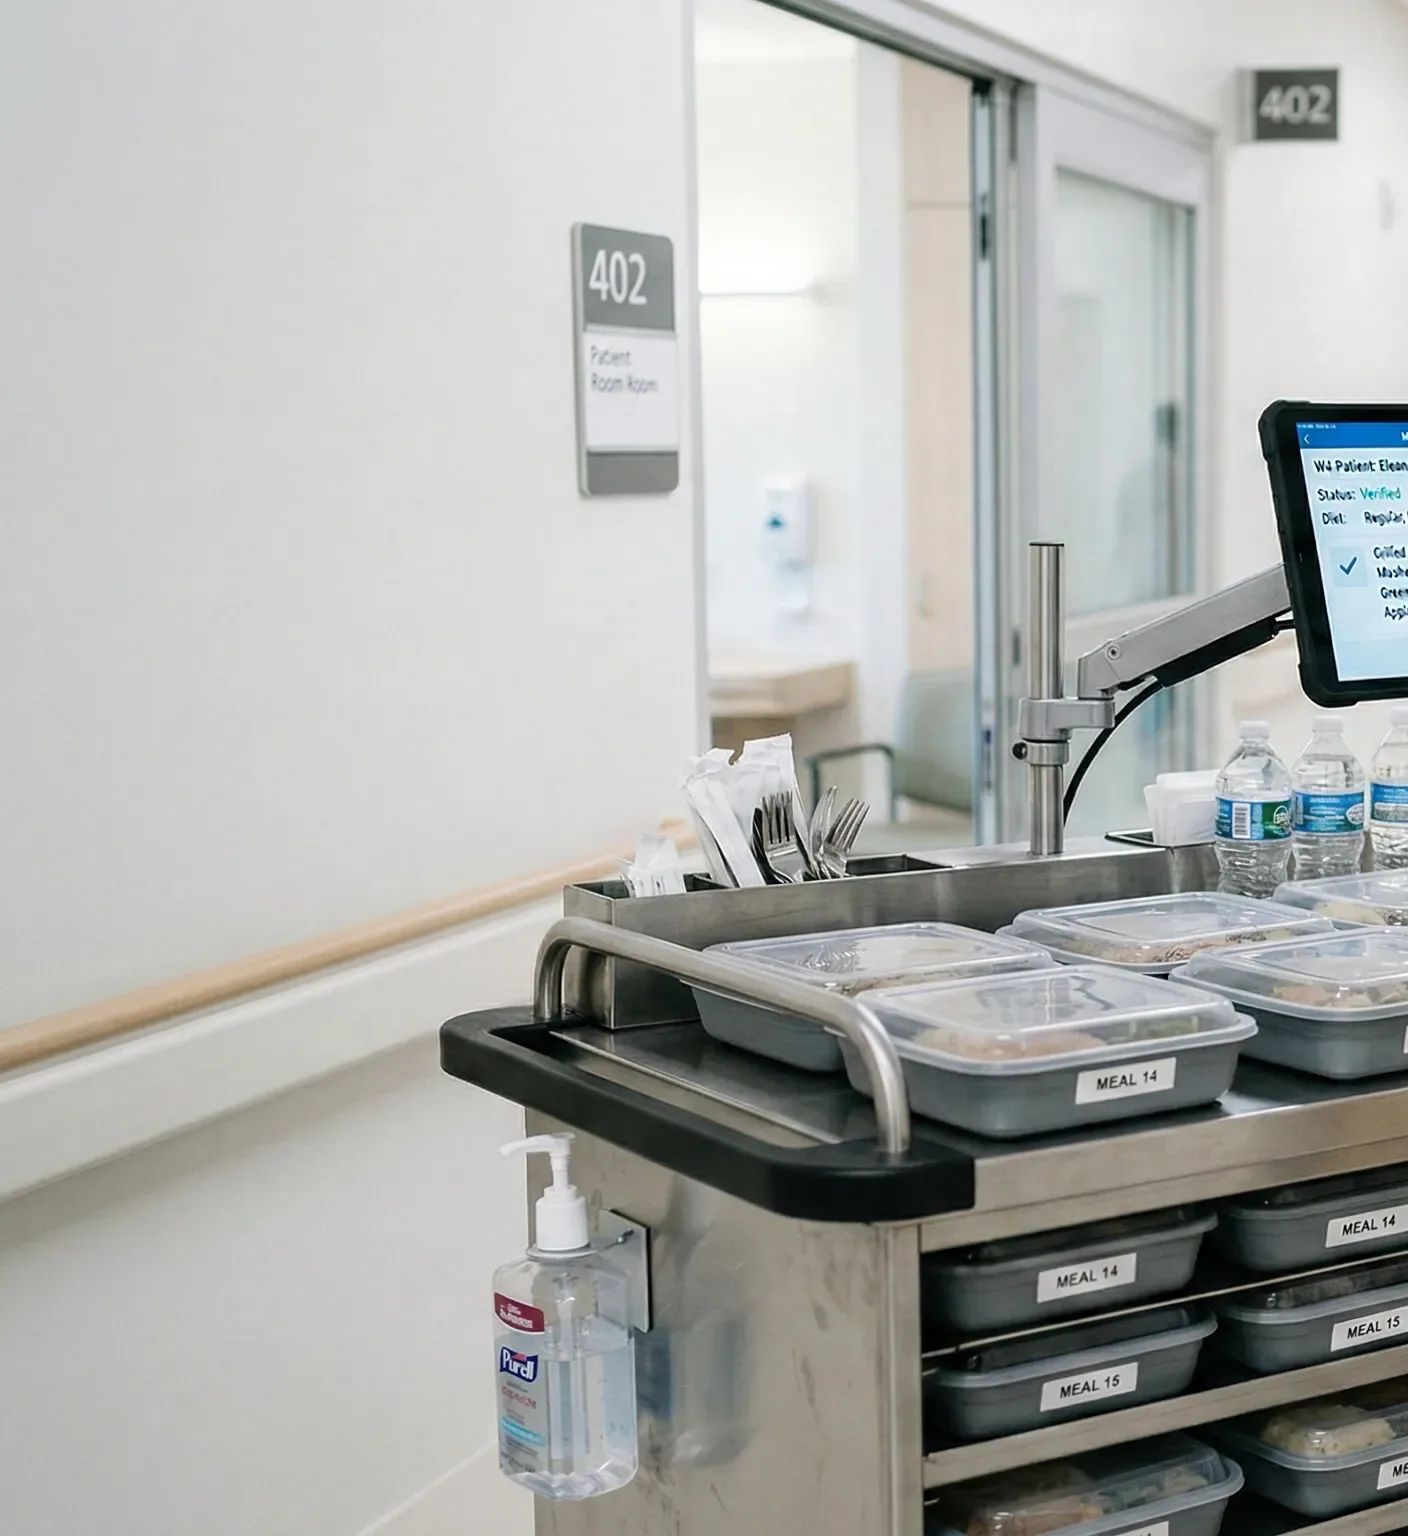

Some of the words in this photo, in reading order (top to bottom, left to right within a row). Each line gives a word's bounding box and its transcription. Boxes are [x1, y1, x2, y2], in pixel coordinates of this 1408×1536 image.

[1259, 84, 1332, 125] 402
[589, 249, 648, 306] 402
[590, 344, 632, 367] Patient
[591, 371, 623, 393] Room
[1317, 488, 1356, 501] Status:
[1359, 486, 1401, 500] Verified
[1373, 545, 1406, 559] Grilled
[1097, 1073, 1137, 1090] MEAL
[1142, 1070, 1157, 1082] 14
[1342, 1218, 1378, 1236] MEAL
[1381, 1214, 1396, 1228] 14
[1057, 1269, 1097, 1288] MEAL
[1102, 1264, 1118, 1278] 14
[1347, 1321, 1383, 1339] MEAL
[1386, 1315, 1400, 1329] 15
[1060, 1379, 1100, 1398] MEAL
[1104, 1374, 1120, 1388] 15
